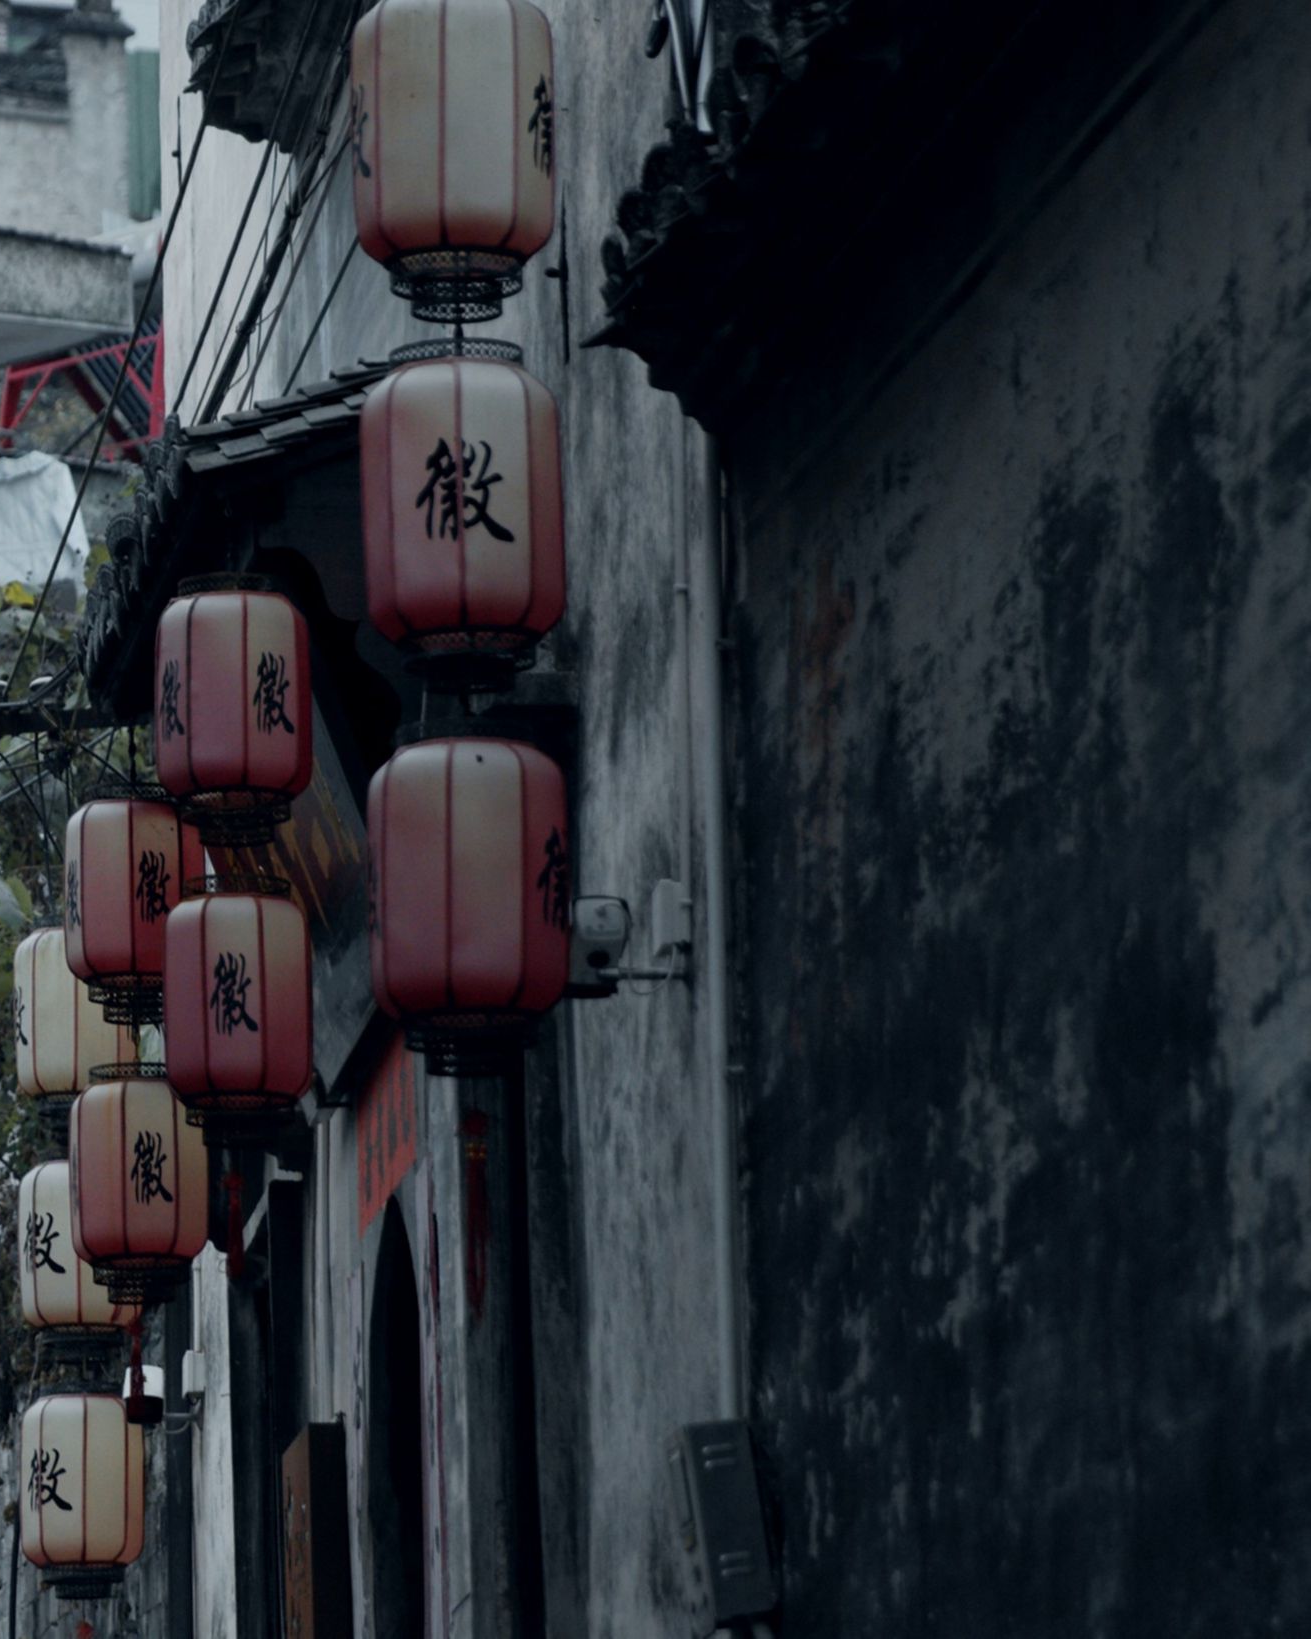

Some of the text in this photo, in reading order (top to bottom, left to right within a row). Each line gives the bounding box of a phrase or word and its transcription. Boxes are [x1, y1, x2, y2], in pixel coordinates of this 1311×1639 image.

[415, 438, 514, 541] 徽
[253, 652, 295, 735] 徽
[210, 952, 258, 1036] 徽
[131, 1131, 173, 1205] 徽
